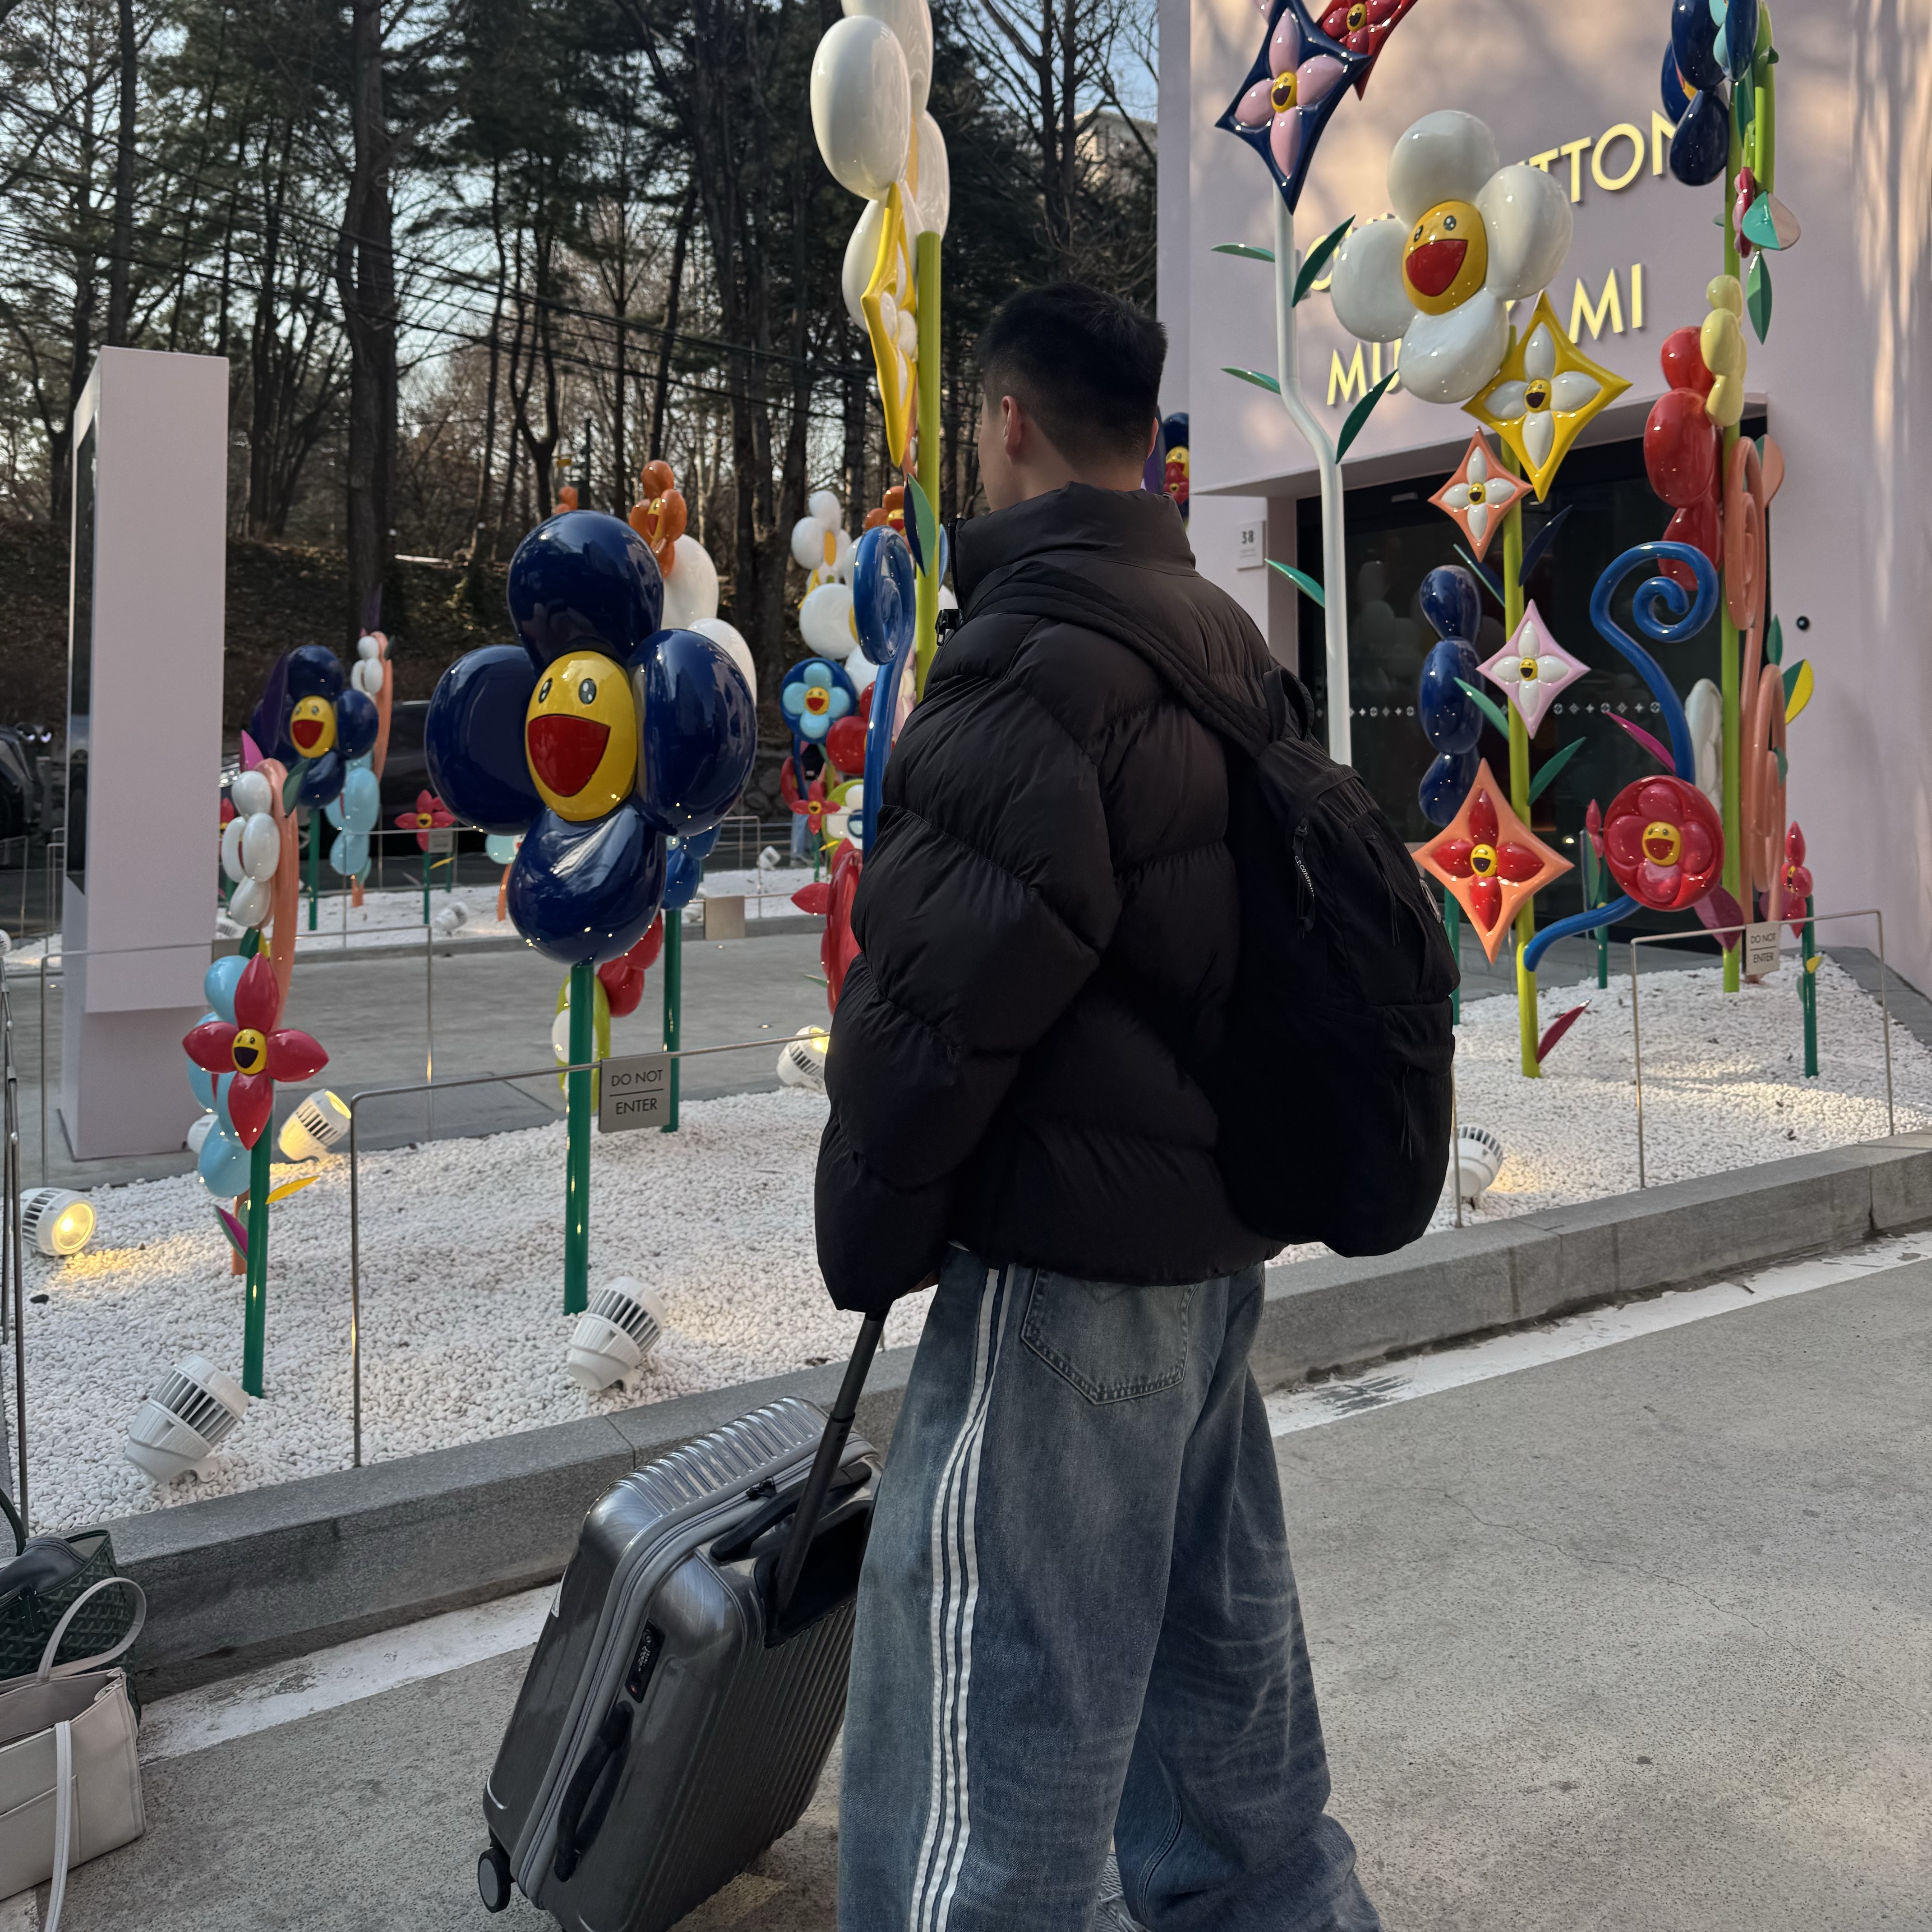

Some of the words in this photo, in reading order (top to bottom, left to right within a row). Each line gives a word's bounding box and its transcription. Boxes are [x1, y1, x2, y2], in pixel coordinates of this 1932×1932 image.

[1241, 529, 1254, 544] 38
[1751, 935, 1761, 944] DO
[1762, 933, 1776, 942] NOT
[1753, 952, 1774, 963] ENTER
[611, 1073, 632, 1086] DO
[635, 1069, 664, 1083] NOT
[616, 1098, 658, 1115] ENTER
